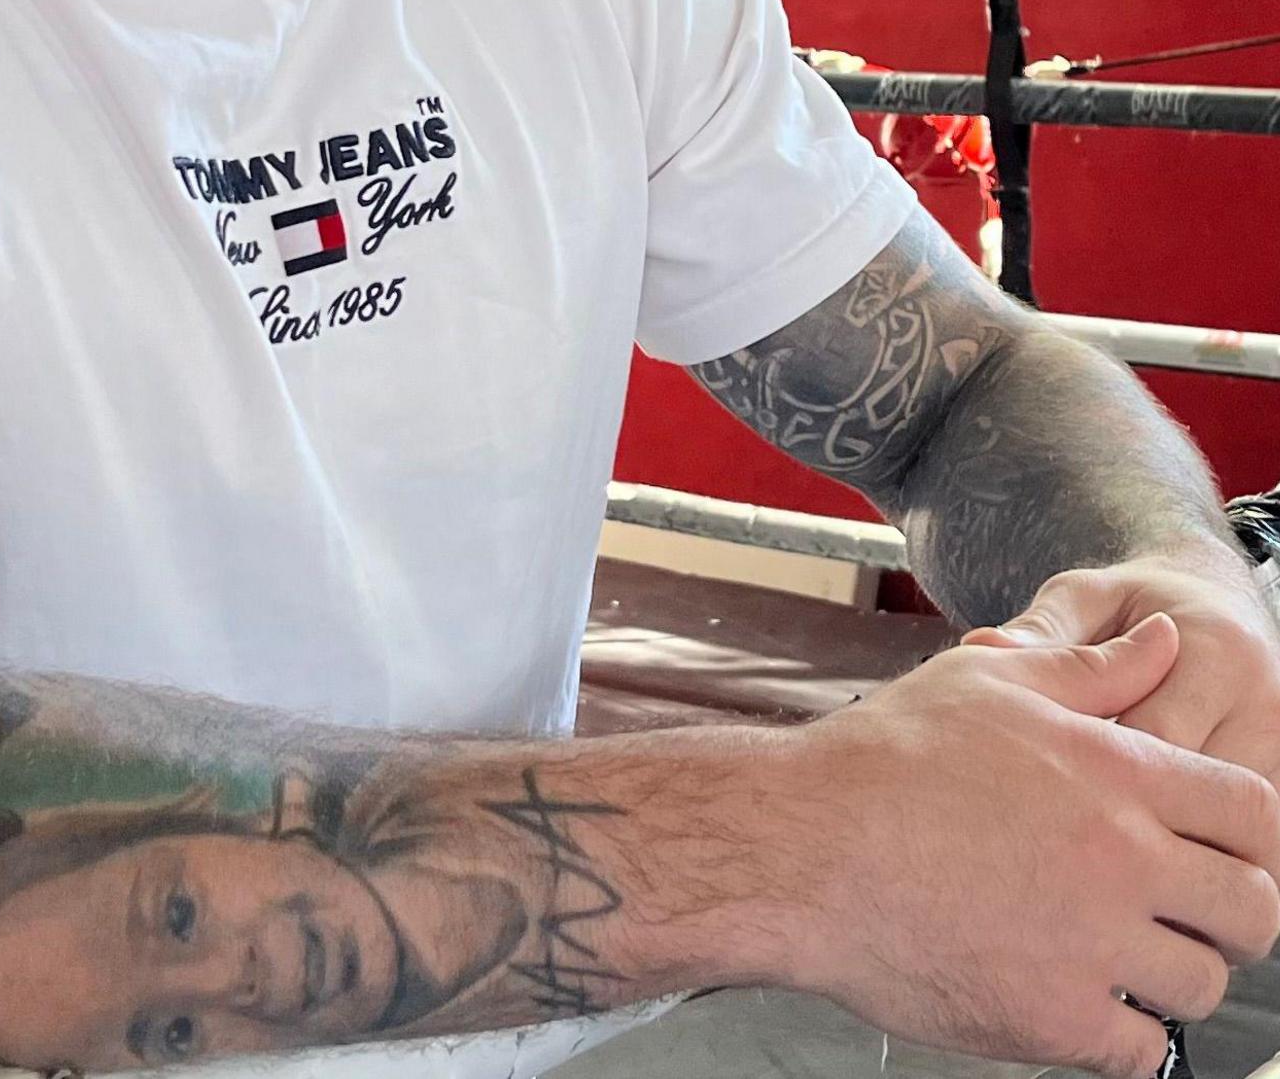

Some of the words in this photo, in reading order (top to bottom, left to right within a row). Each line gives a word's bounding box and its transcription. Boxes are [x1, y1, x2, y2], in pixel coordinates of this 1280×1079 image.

[319, 117, 457, 184] JEANS
[357, 172, 458, 256] York
[327, 276, 407, 327] 1985
